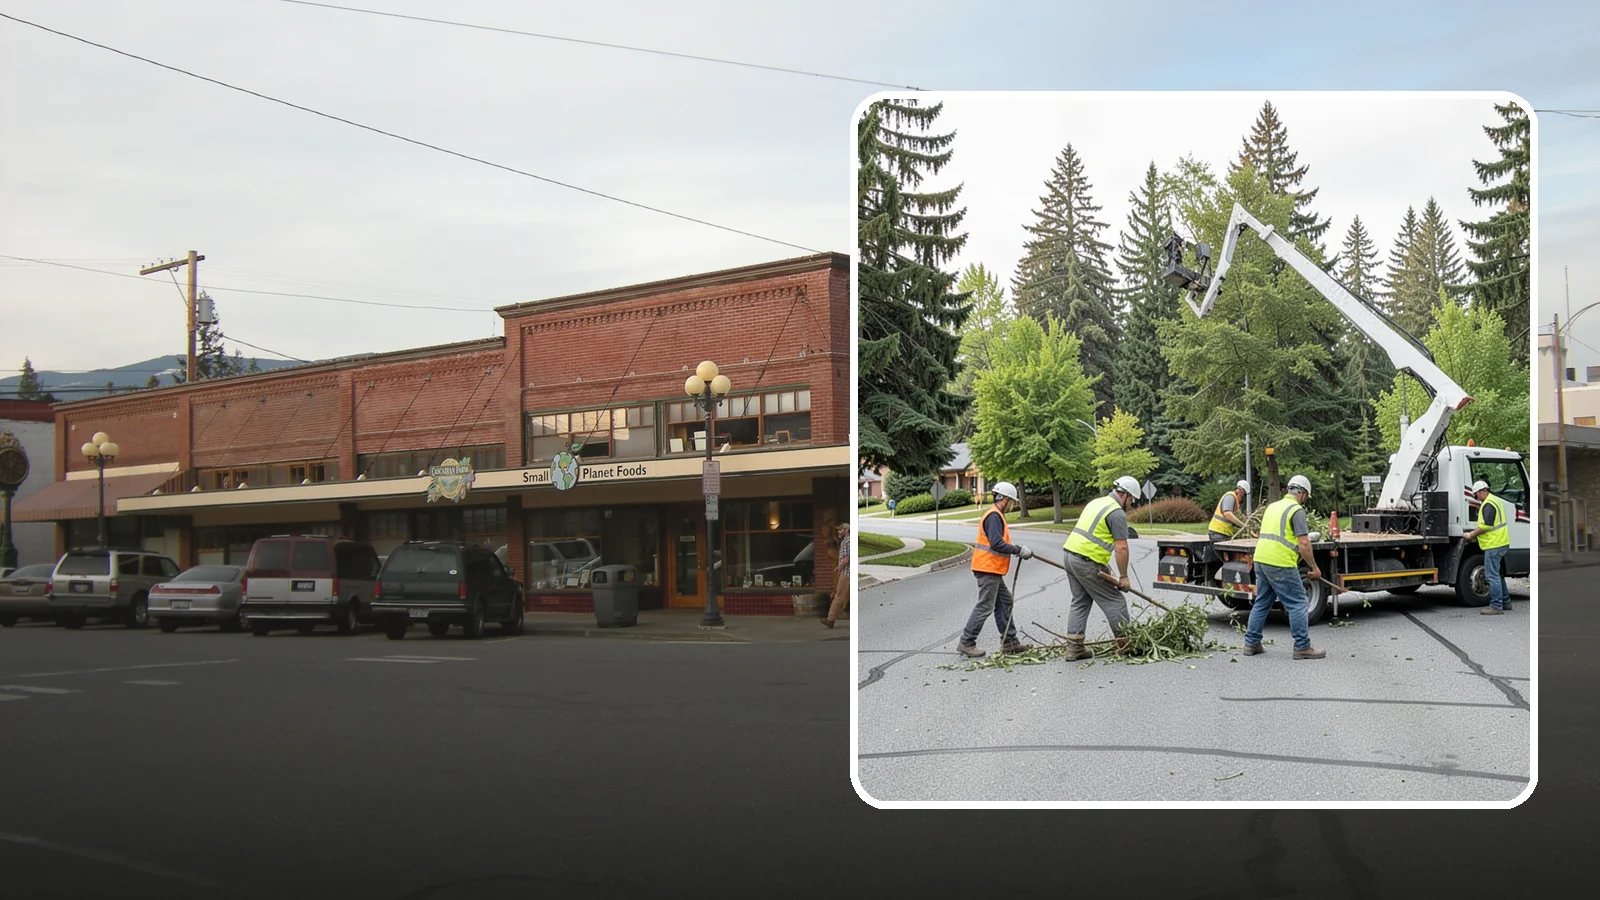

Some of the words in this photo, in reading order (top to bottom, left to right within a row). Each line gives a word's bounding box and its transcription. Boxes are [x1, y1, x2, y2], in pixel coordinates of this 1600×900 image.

[523, 471, 549, 483] Small
[583, 467, 614, 479] Planet
[616, 464, 647, 476] Foods
